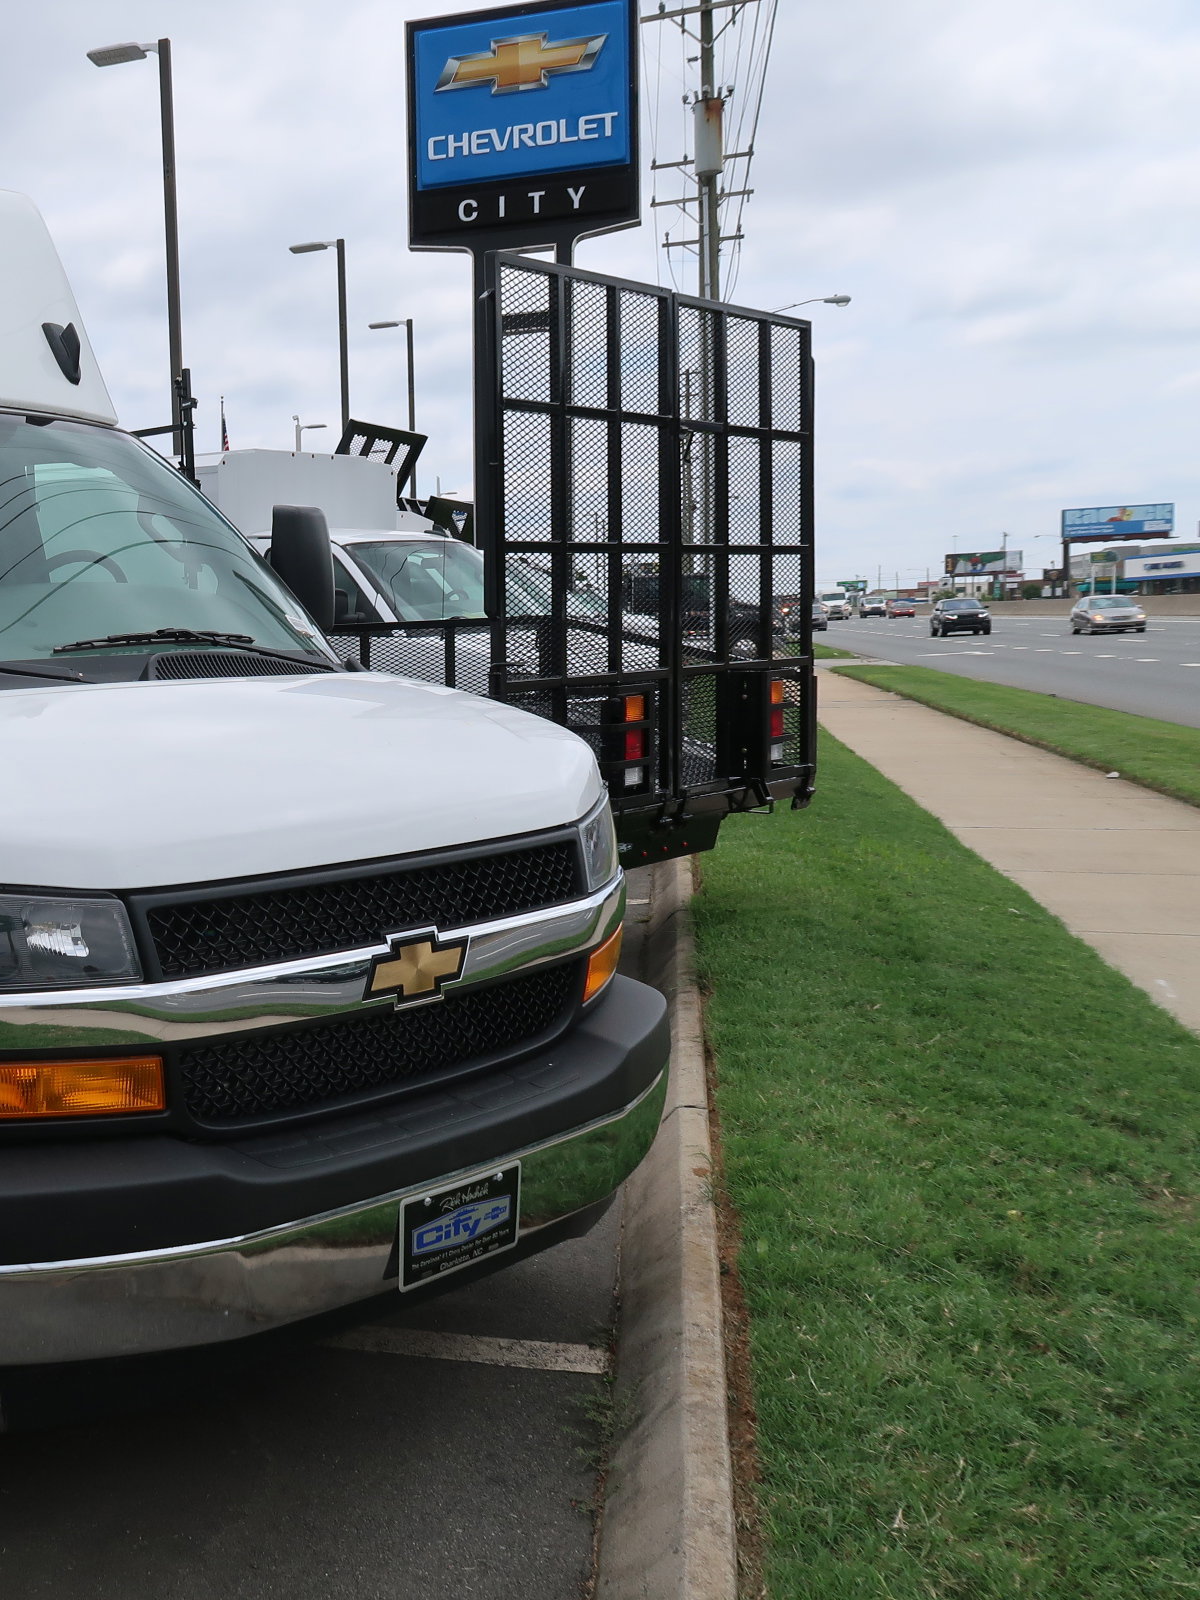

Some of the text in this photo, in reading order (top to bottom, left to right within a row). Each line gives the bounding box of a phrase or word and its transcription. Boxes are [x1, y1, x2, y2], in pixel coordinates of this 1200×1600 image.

[427, 111, 619, 161] CHEVROLET
[458, 186, 586, 222] CITY
[416, 1216, 482, 1249] City
